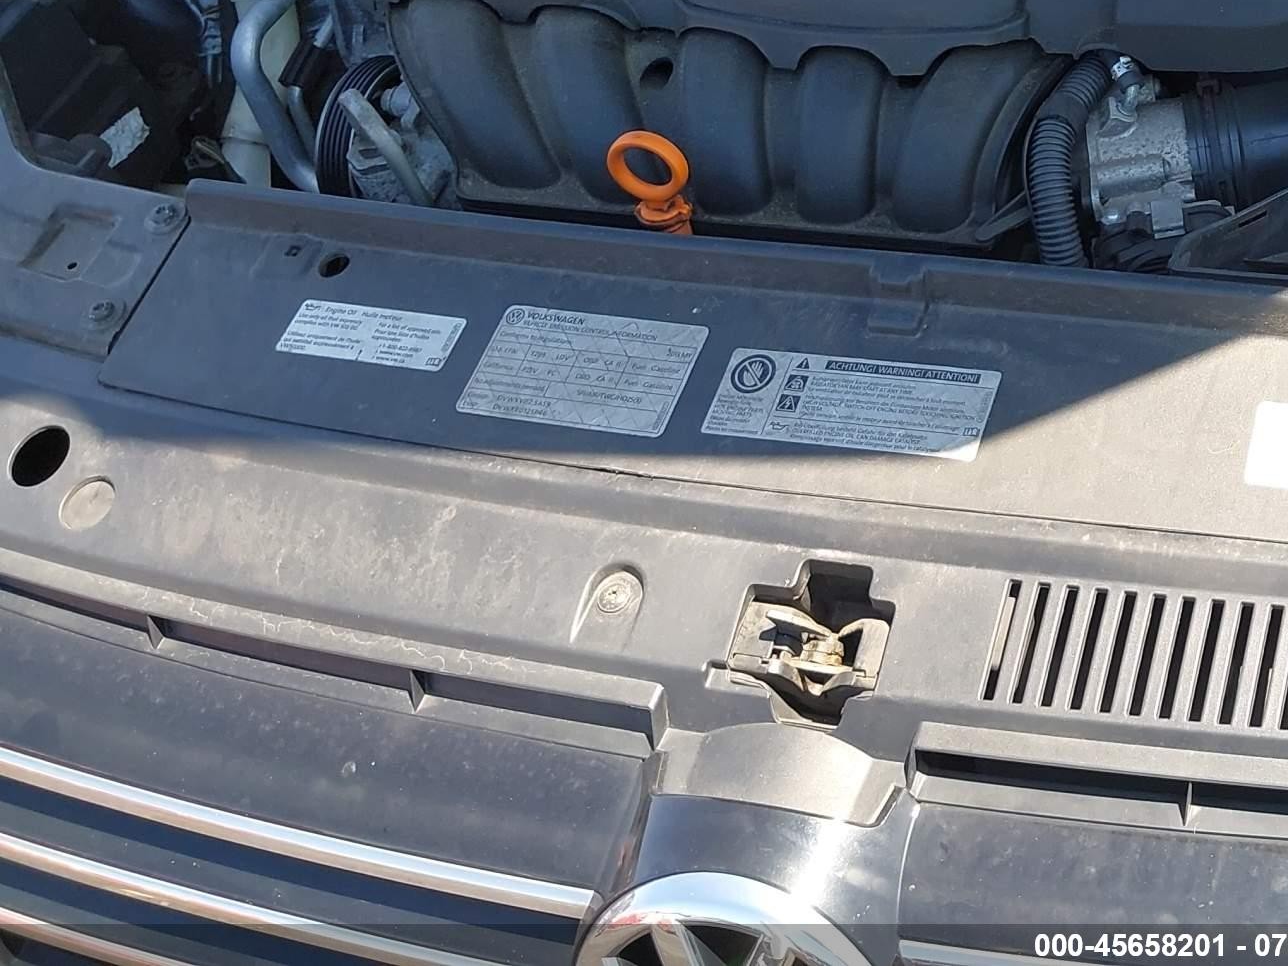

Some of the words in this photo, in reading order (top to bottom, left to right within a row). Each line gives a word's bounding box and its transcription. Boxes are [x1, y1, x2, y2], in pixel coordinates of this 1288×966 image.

[325, 306, 346, 315] Engine
[527, 312, 586, 325] VOLKSWAGEN
[829, 361, 877, 373] ACHTUNG!
[878, 366, 925, 378] WARNING!
[925, 370, 979, 383] ATTENTION!
